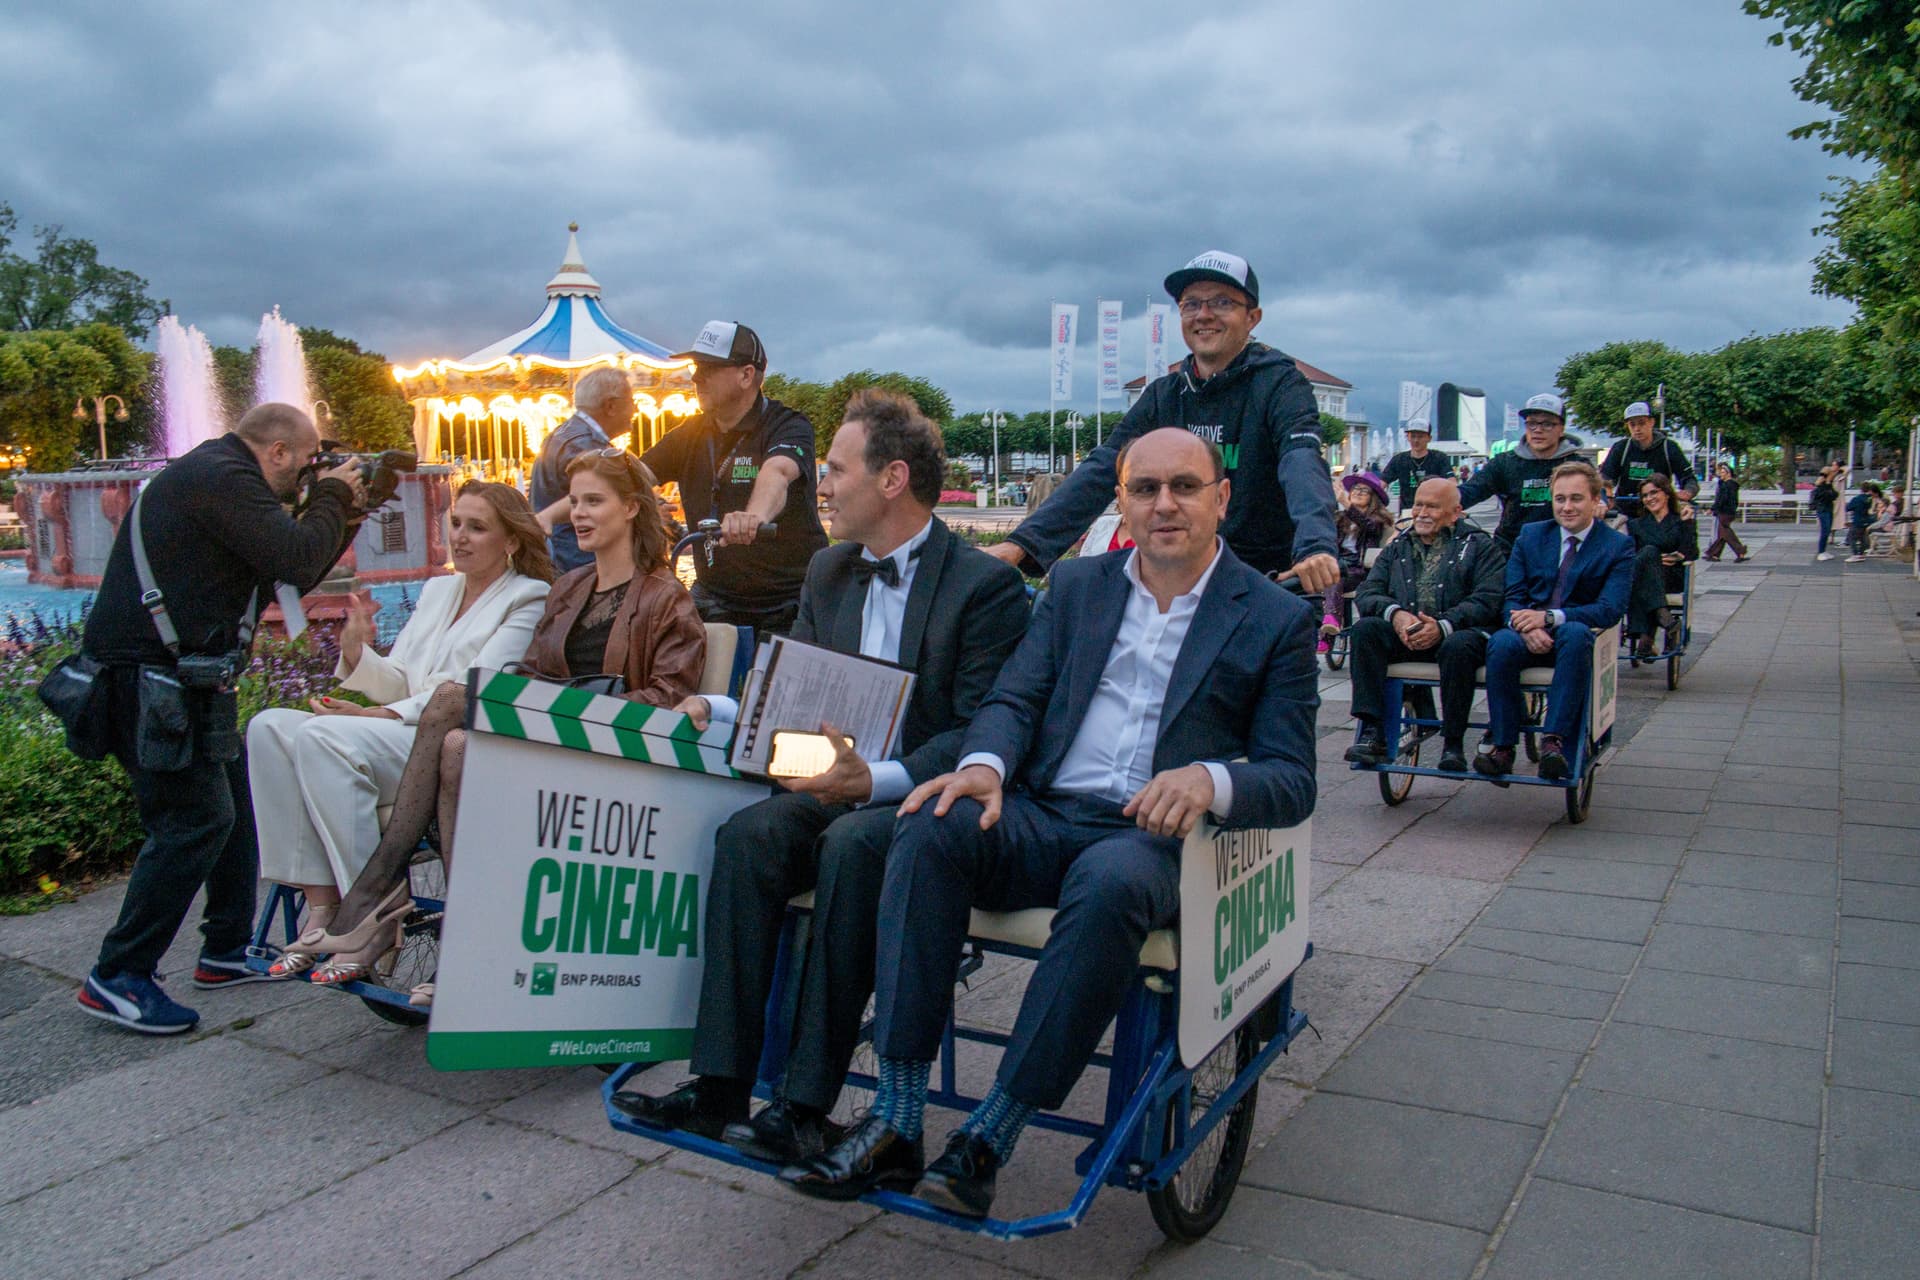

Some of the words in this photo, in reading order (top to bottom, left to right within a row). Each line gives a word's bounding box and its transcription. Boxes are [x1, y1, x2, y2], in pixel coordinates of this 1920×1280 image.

[538, 789, 587, 849] WE
[591, 797, 660, 860] LOVE
[521, 857, 700, 957] CINEMA
[1214, 847, 1295, 986] CINEMA
[514, 969, 528, 988] by
[560, 973, 588, 987] BNP
[590, 974, 641, 988] PARIBAS
[549, 1039, 651, 1056] #WeLoveCinema
